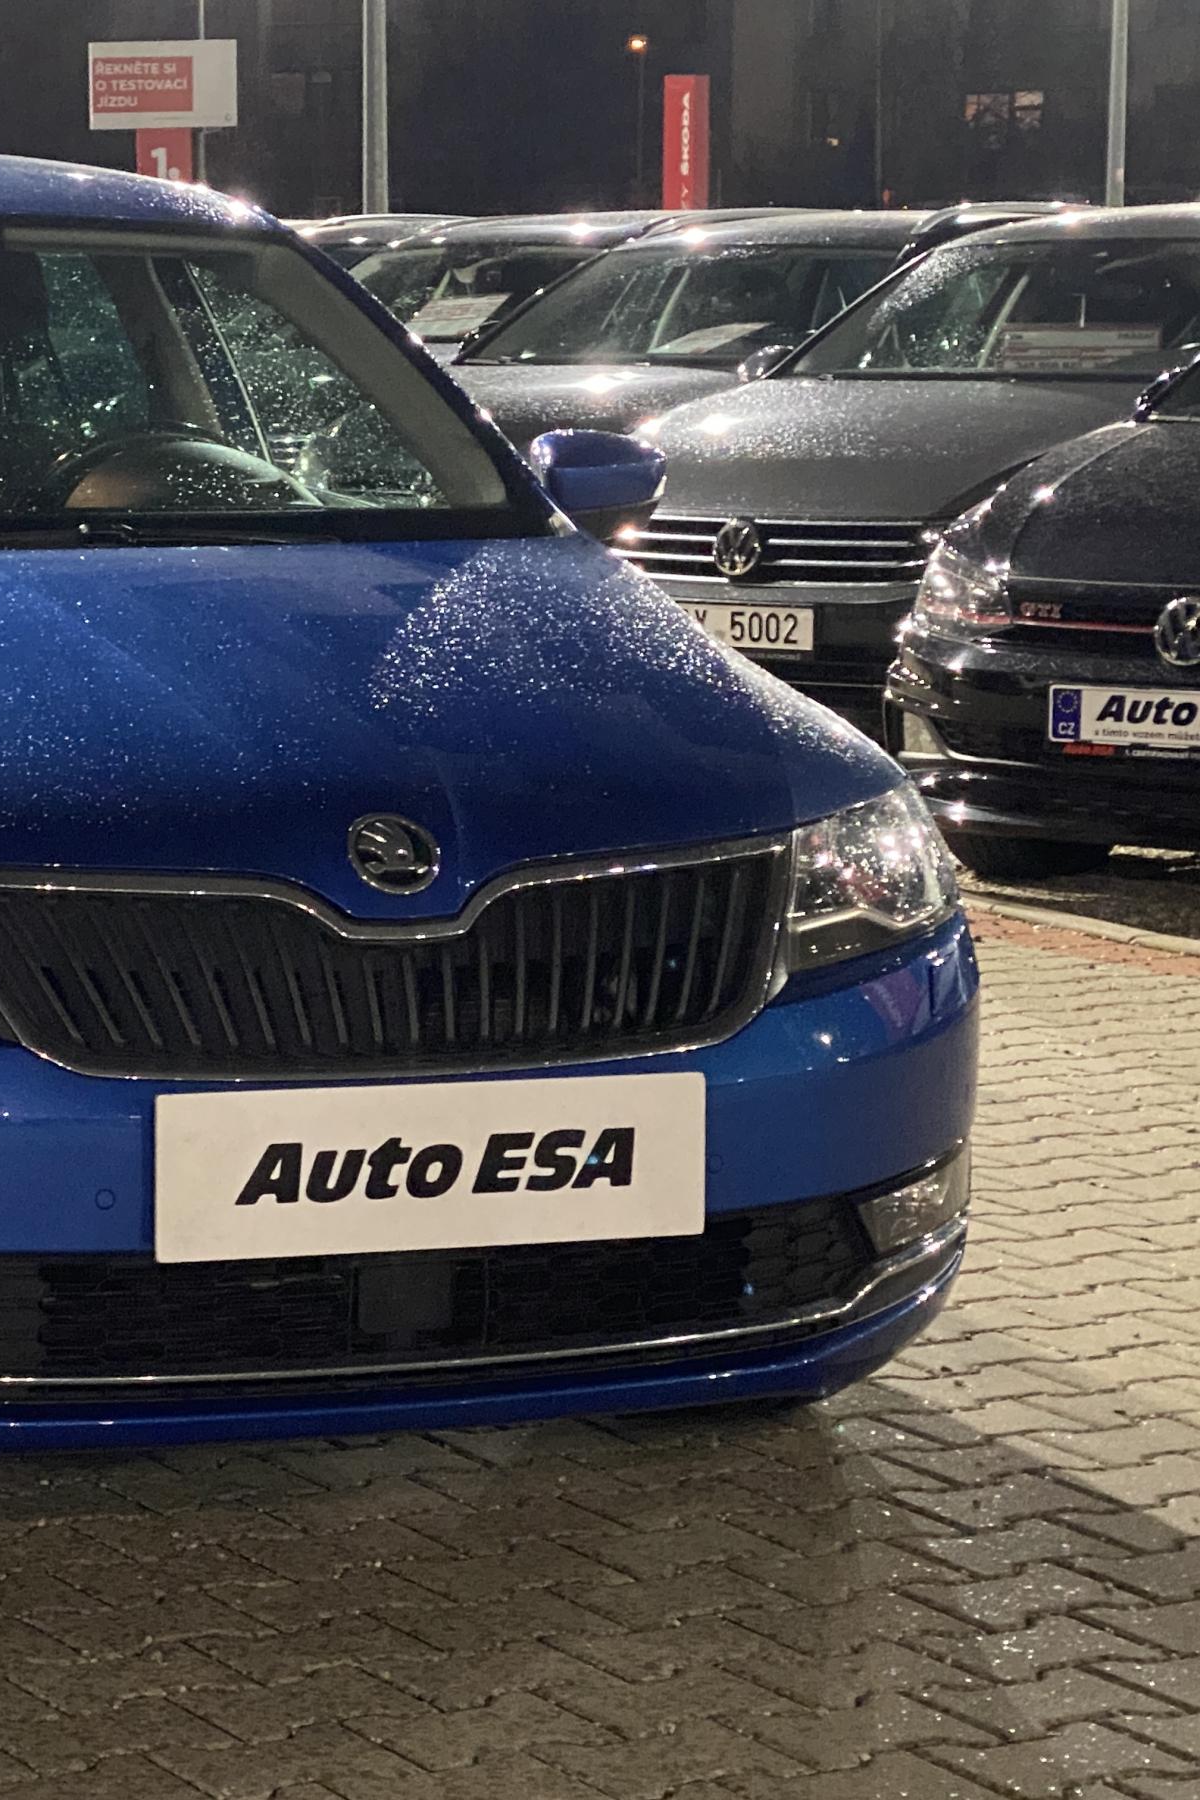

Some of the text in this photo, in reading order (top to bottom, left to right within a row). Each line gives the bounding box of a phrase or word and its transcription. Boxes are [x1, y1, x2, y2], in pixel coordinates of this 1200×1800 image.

[95, 61, 177, 75] ŘEKNĚTE SI
[95, 75, 187, 91] O TESTOVACÍ
[97, 94, 138, 108] JÍZDU
[729, 611, 799, 644] 5002
[1096, 695, 1198, 727] Auto
[1058, 722, 1075, 735] CZ
[235, 1127, 635, 1206] Auto ESA
